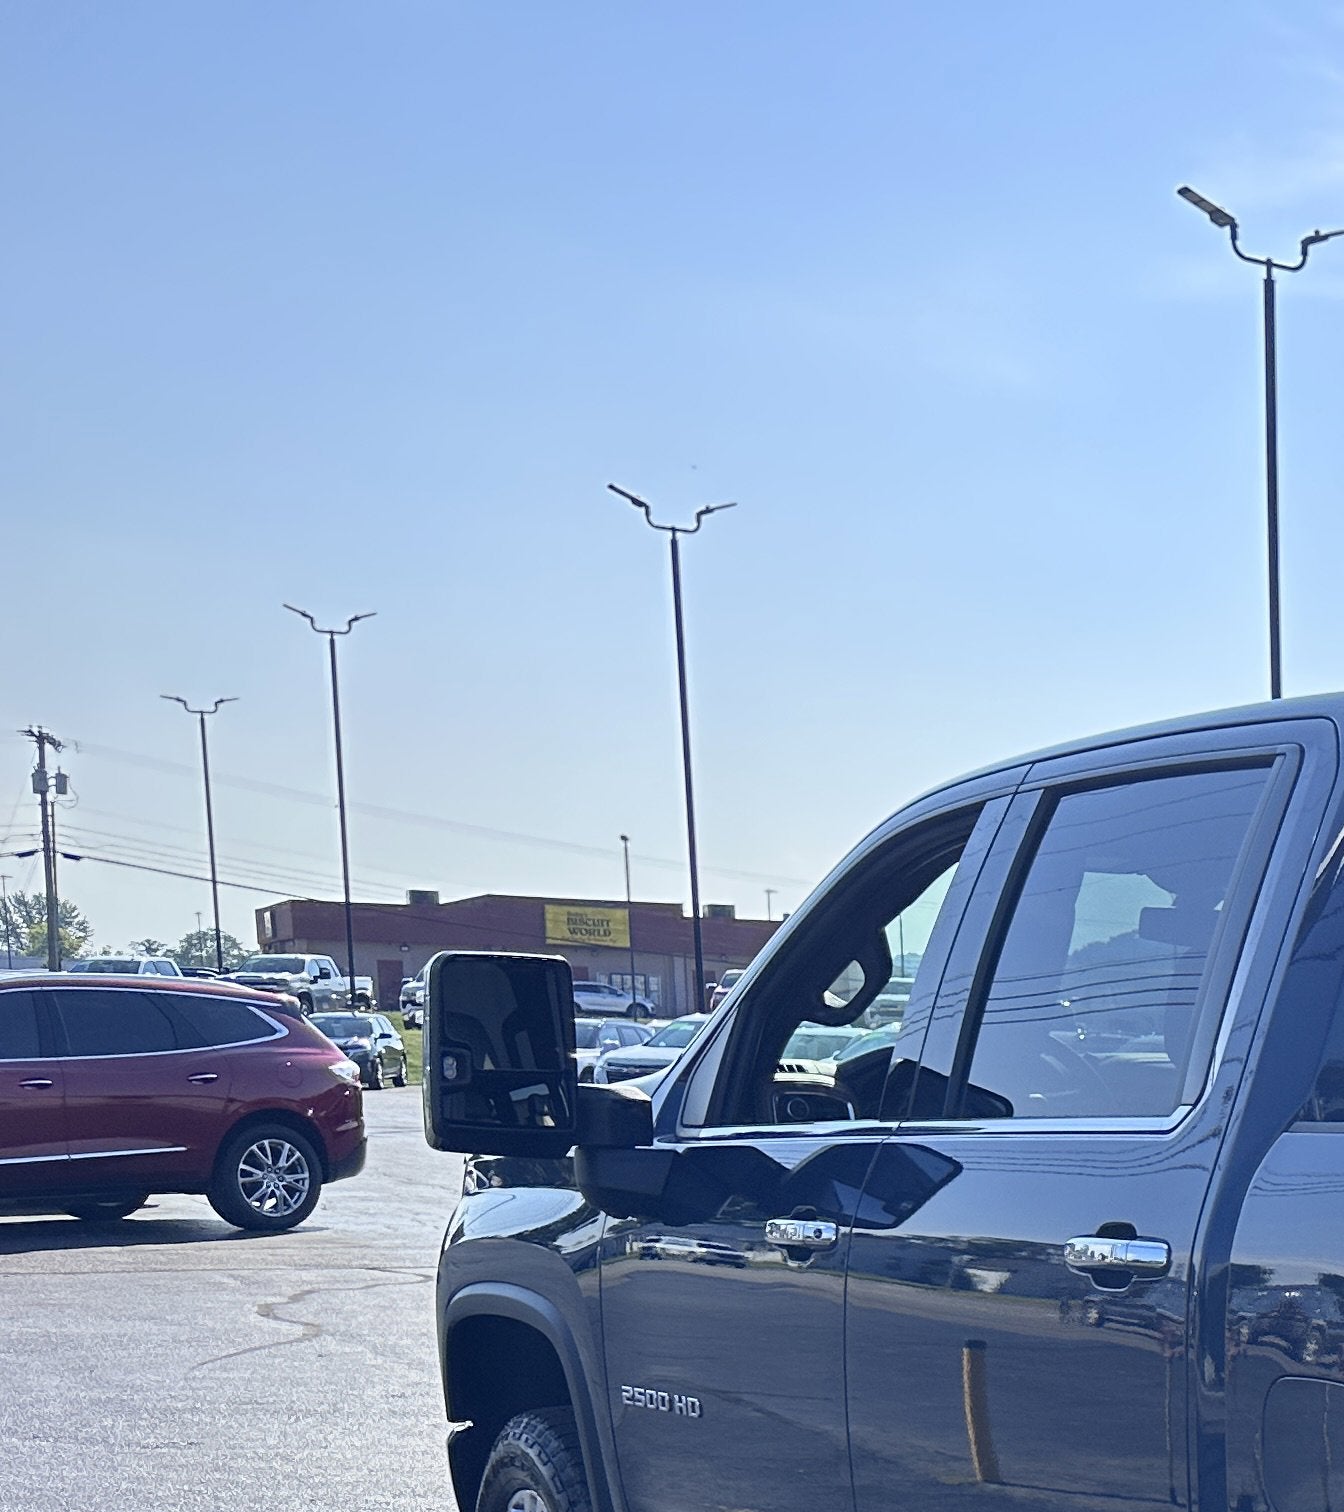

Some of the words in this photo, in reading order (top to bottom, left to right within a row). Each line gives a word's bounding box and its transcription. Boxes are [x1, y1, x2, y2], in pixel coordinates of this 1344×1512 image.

[566, 917, 611, 928] BISCUIT
[567, 928, 611, 937] WORLD
[621, 1385, 670, 1412] 2500
[673, 1394, 701, 1418] HD
